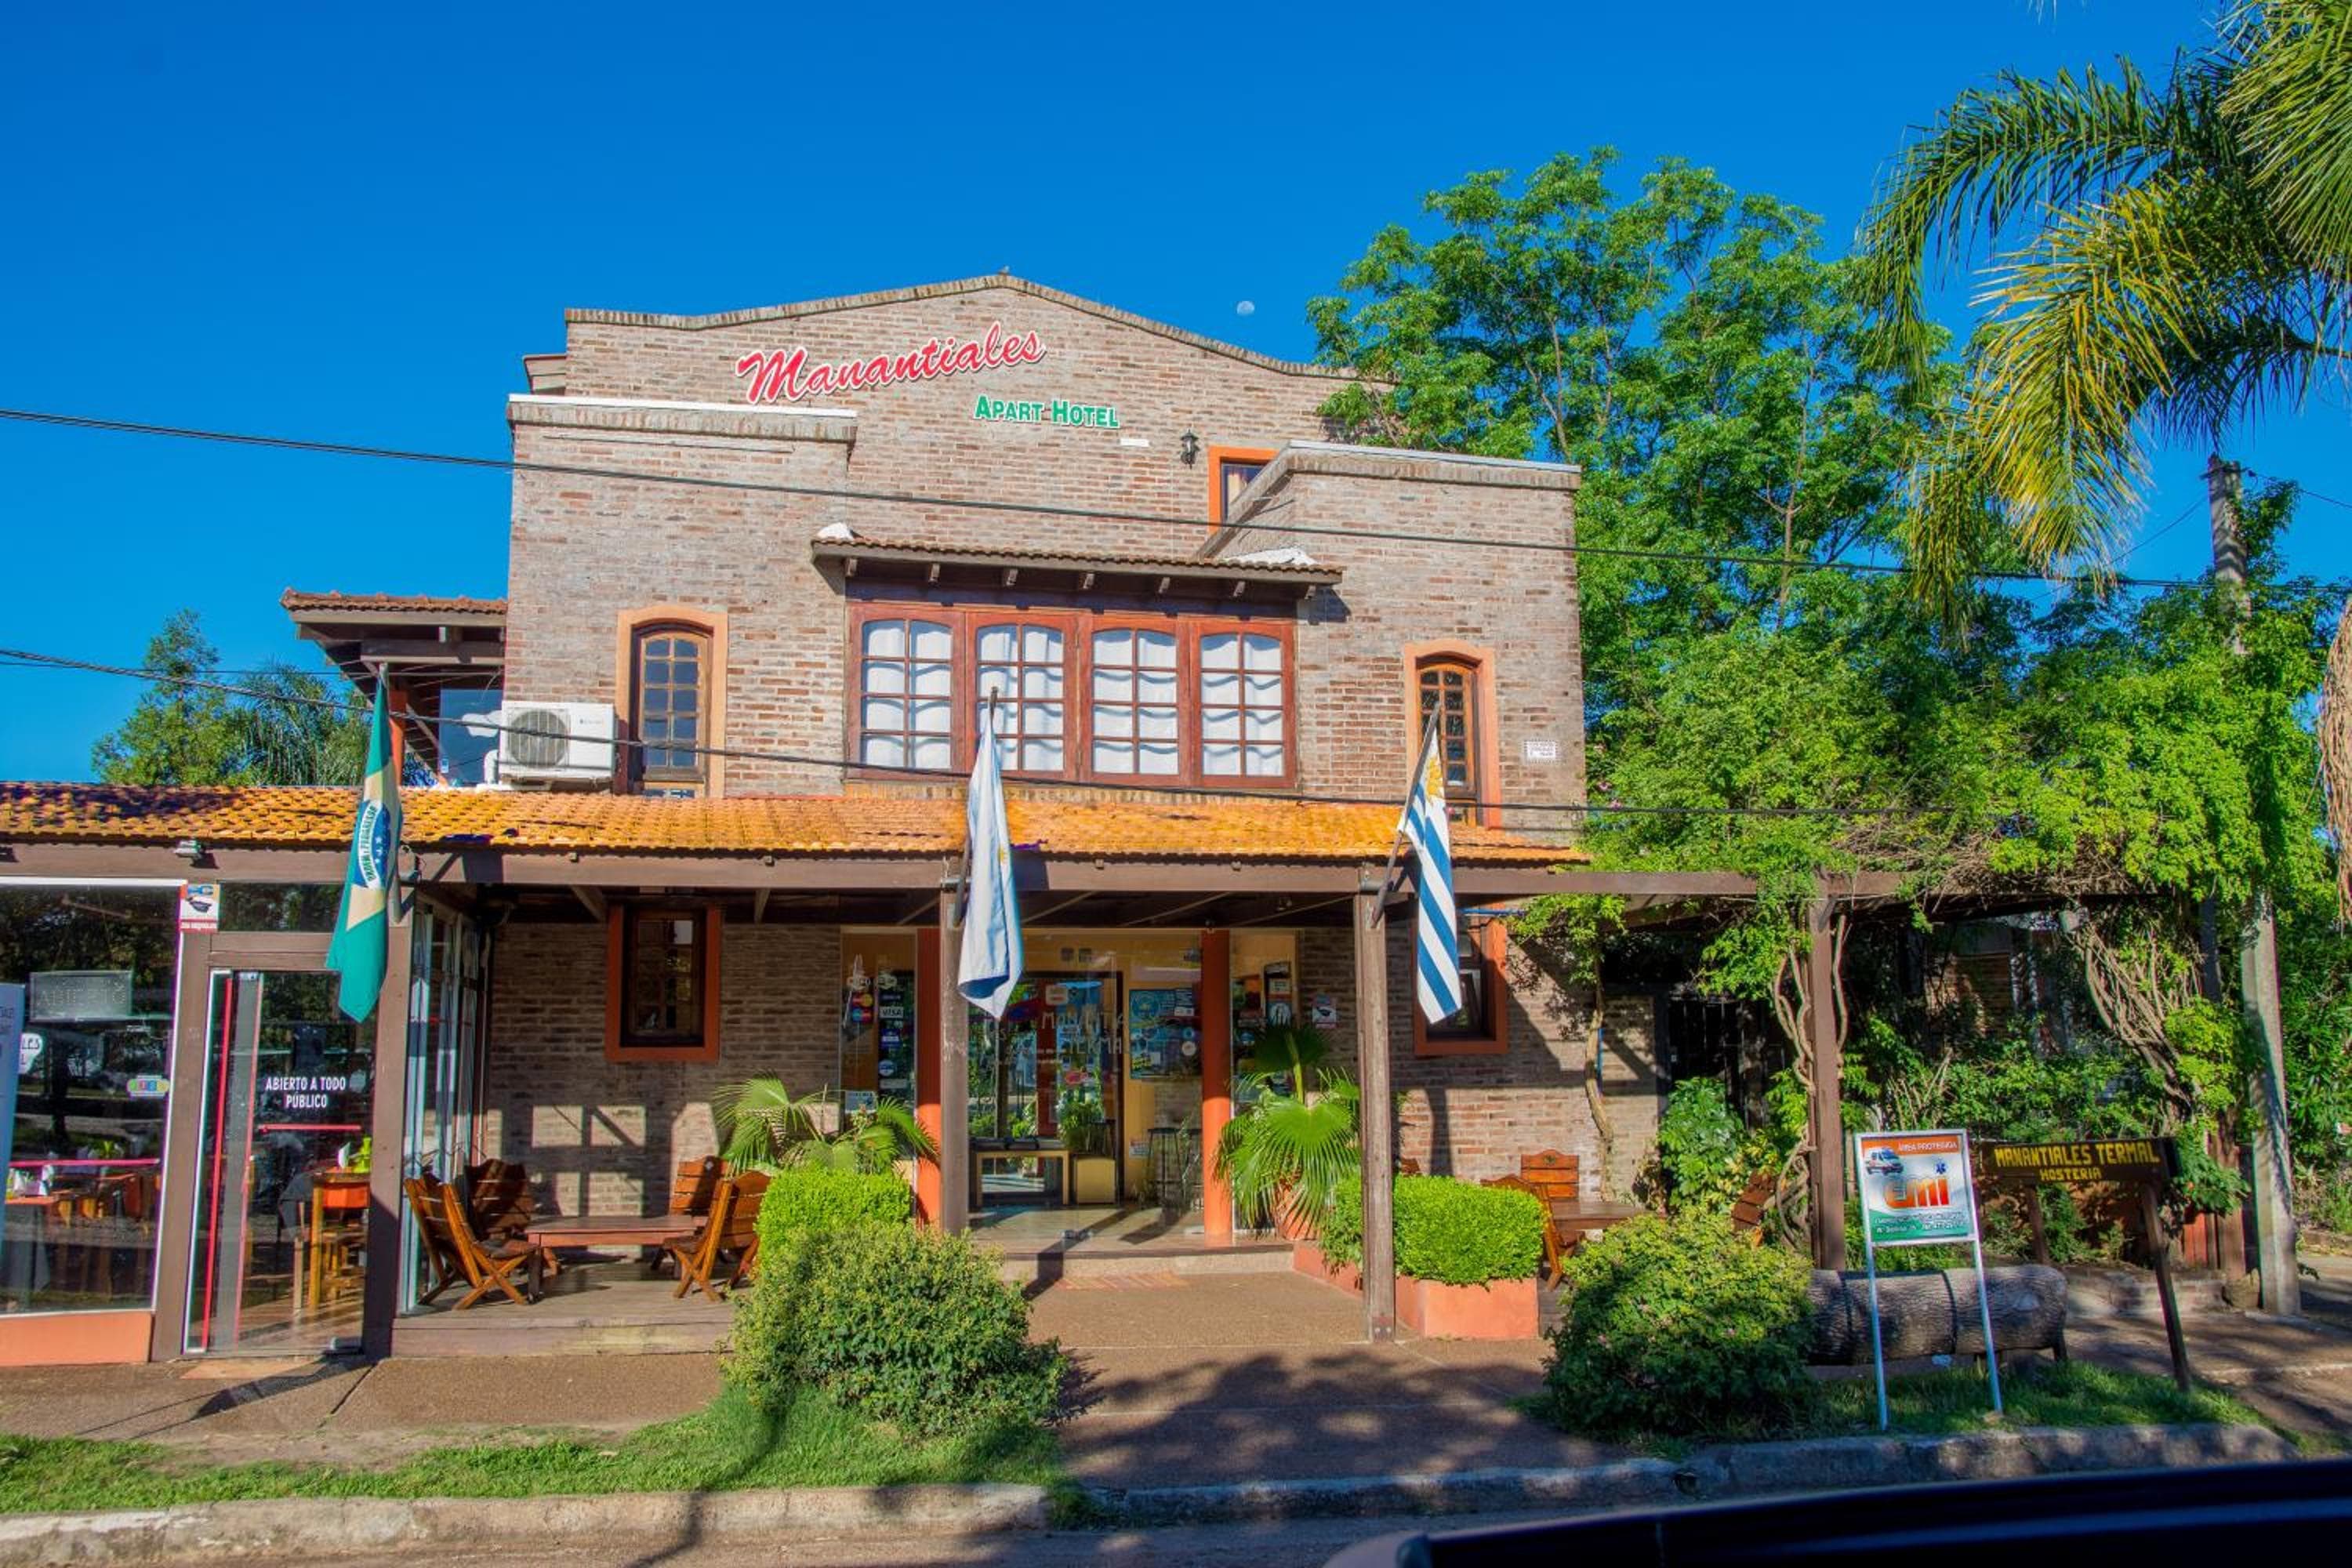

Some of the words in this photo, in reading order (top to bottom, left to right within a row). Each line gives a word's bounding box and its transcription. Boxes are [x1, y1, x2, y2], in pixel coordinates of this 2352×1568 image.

[735, 320, 1047, 405] Manantiales
[974, 394, 1044, 422] APART
[1051, 400, 1120, 428] HOTEL
[266, 1076, 307, 1091] ABIERTO
[310, 1076, 318, 1091] A
[319, 1076, 346, 1091] TODO
[285, 1091, 328, 1108] PÚBLICO
[1994, 1144, 2091, 1167] MANANTIALES
[2094, 1141, 2161, 1163] TERMAL
[2039, 1166, 2102, 1181] HOSTERIA
